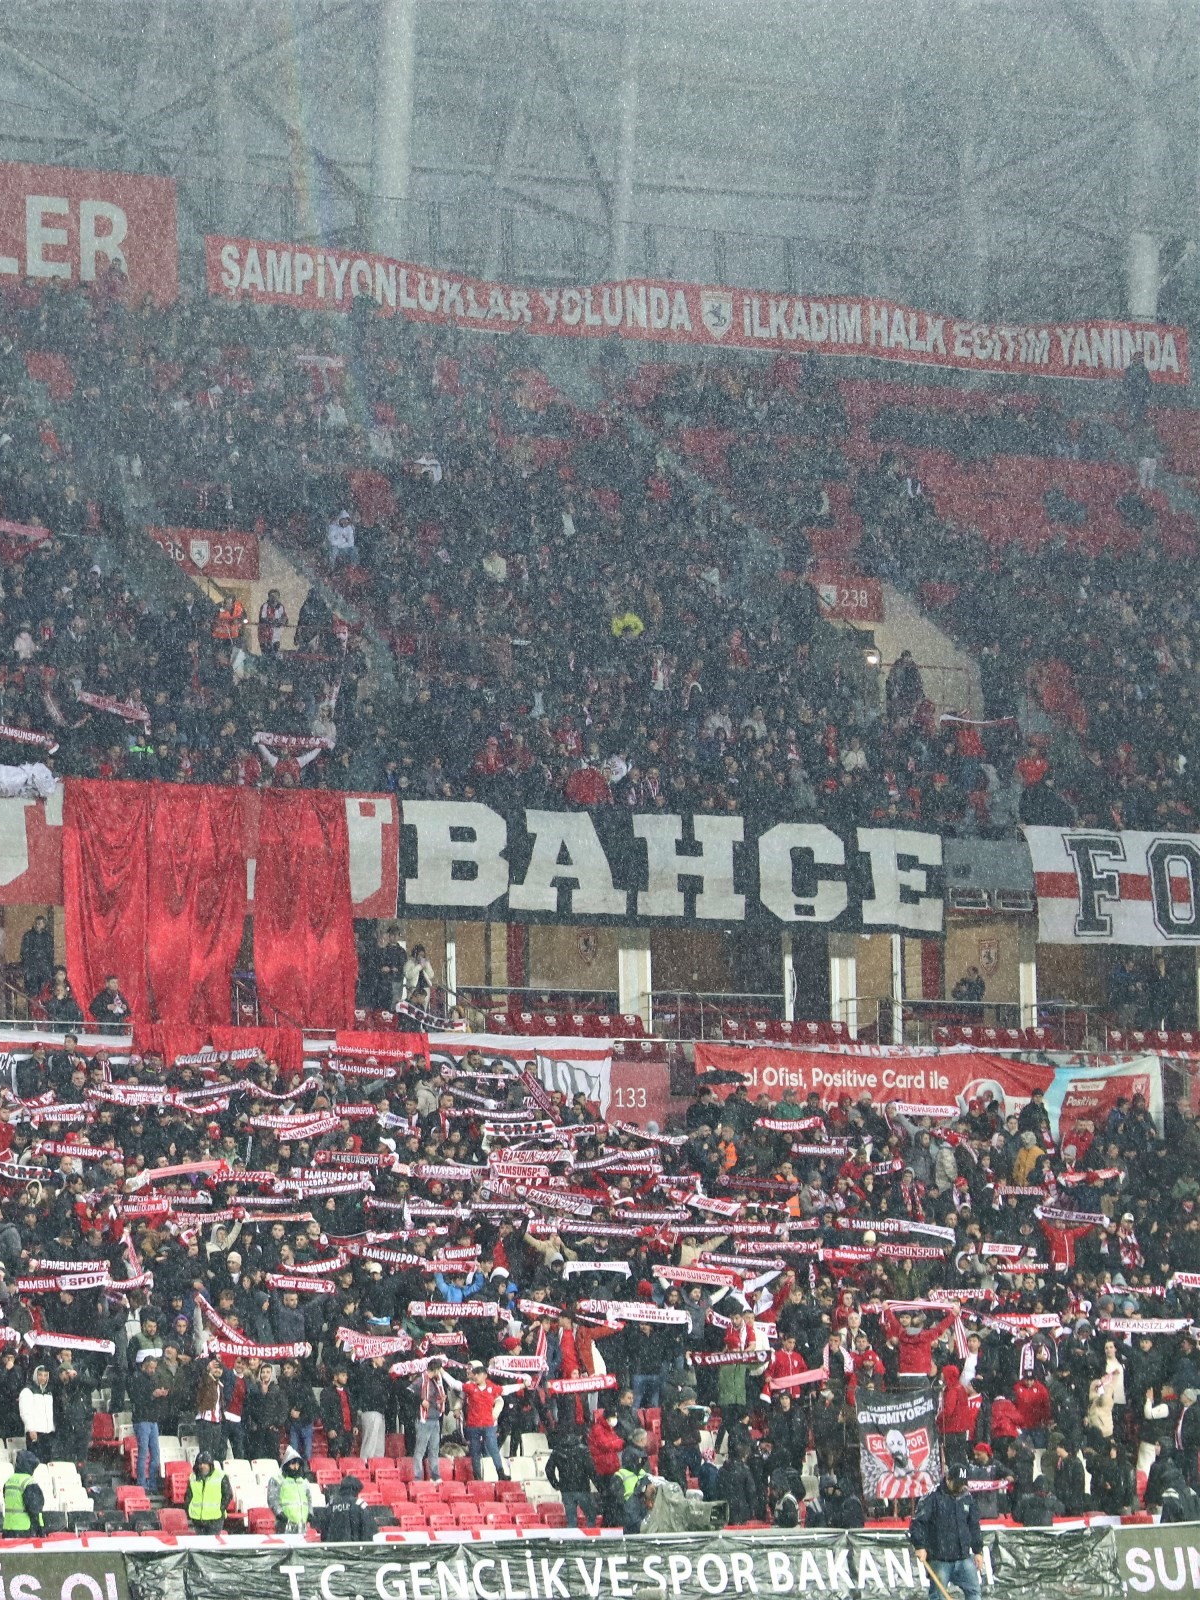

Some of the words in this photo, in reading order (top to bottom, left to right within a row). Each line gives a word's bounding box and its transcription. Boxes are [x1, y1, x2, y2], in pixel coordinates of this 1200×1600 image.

[541, 287, 691, 331] YOLUNDA
[870, 304, 948, 355] HALK
[1059, 326, 1180, 374] YANINDA
[212, 545, 245, 566] 237
[840, 588, 868, 608] 238
[404, 800, 943, 932] BAHÇE
[340, 1063, 384, 1076] SAMSUNSPOR
[762, 1067, 807, 1090] Ofisi,
[812, 1067, 878, 1089] Positive
[882, 1069, 926, 1090] Card
[929, 1070, 950, 1090] ile
[614, 1087, 648, 1109] 133
[287, 1119, 334, 1140] SAMSUNSPOR
[494, 1122, 544, 1135] FORZA
[57, 1145, 108, 1157] SAMSUNSPOR
[798, 1145, 845, 1155] SAMSUNSPOR
[331, 1154, 380, 1164] SAMSUNSPOR
[502, 1151, 558, 1163] SAMSUNSPOR
[304, 1169, 359, 1181] SAMSUNSPOR
[422, 1164, 472, 1176] HATAYSPOR
[851, 1220, 899, 1232] SAMSUNSPOR
[362, 1247, 419, 1265] SAMSUNSPOR
[882, 1243, 941, 1257] SAMSUNSPOR
[40, 1260, 99, 1271] SAMSUNSPOR
[997, 1262, 1049, 1272] SAMSUNSPOR
[18, 1279, 56, 1290] SAMSUN
[69, 1274, 105, 1287] SPOR
[670, 1268, 722, 1283] SAMSUNSPOR
[426, 1305, 484, 1317] SAMSUNSPOR
[1113, 1320, 1176, 1331] MEKANSIZLAR
[219, 1343, 291, 1357] SAMSUNSPOR
[562, 1380, 606, 1392] SAMSUNSPOR
[959, 1468, 967, 1479] M
[574, 1556, 637, 1600] VE
[643, 1552, 759, 1598] SPOR
